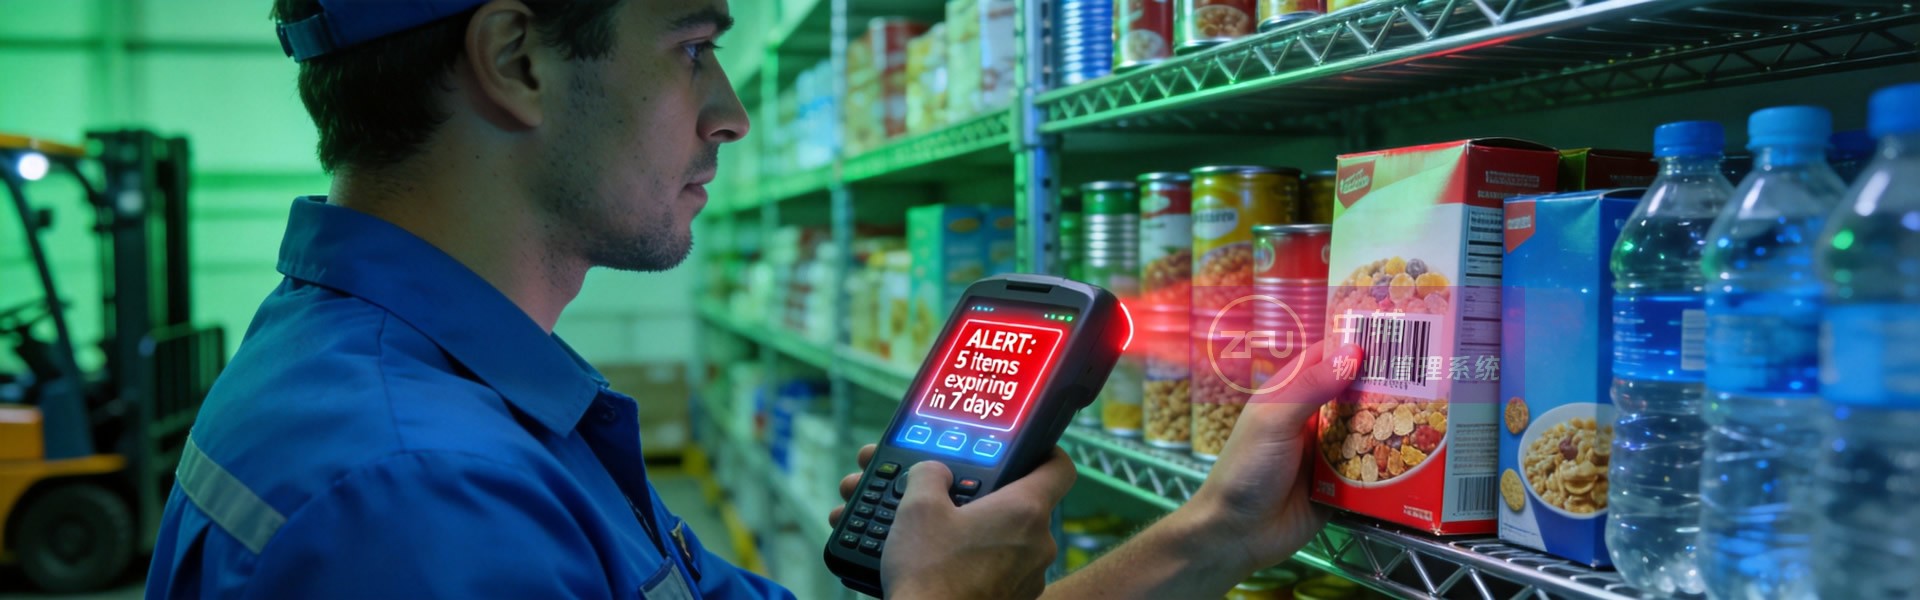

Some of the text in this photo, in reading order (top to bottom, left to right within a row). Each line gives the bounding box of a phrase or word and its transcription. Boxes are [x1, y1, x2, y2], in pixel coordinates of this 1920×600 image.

[966, 328, 1037, 355] ALERT:
[954, 350, 1020, 375] 5 items
[944, 373, 1018, 400] expiring
[929, 389, 1005, 420] in 7 days
